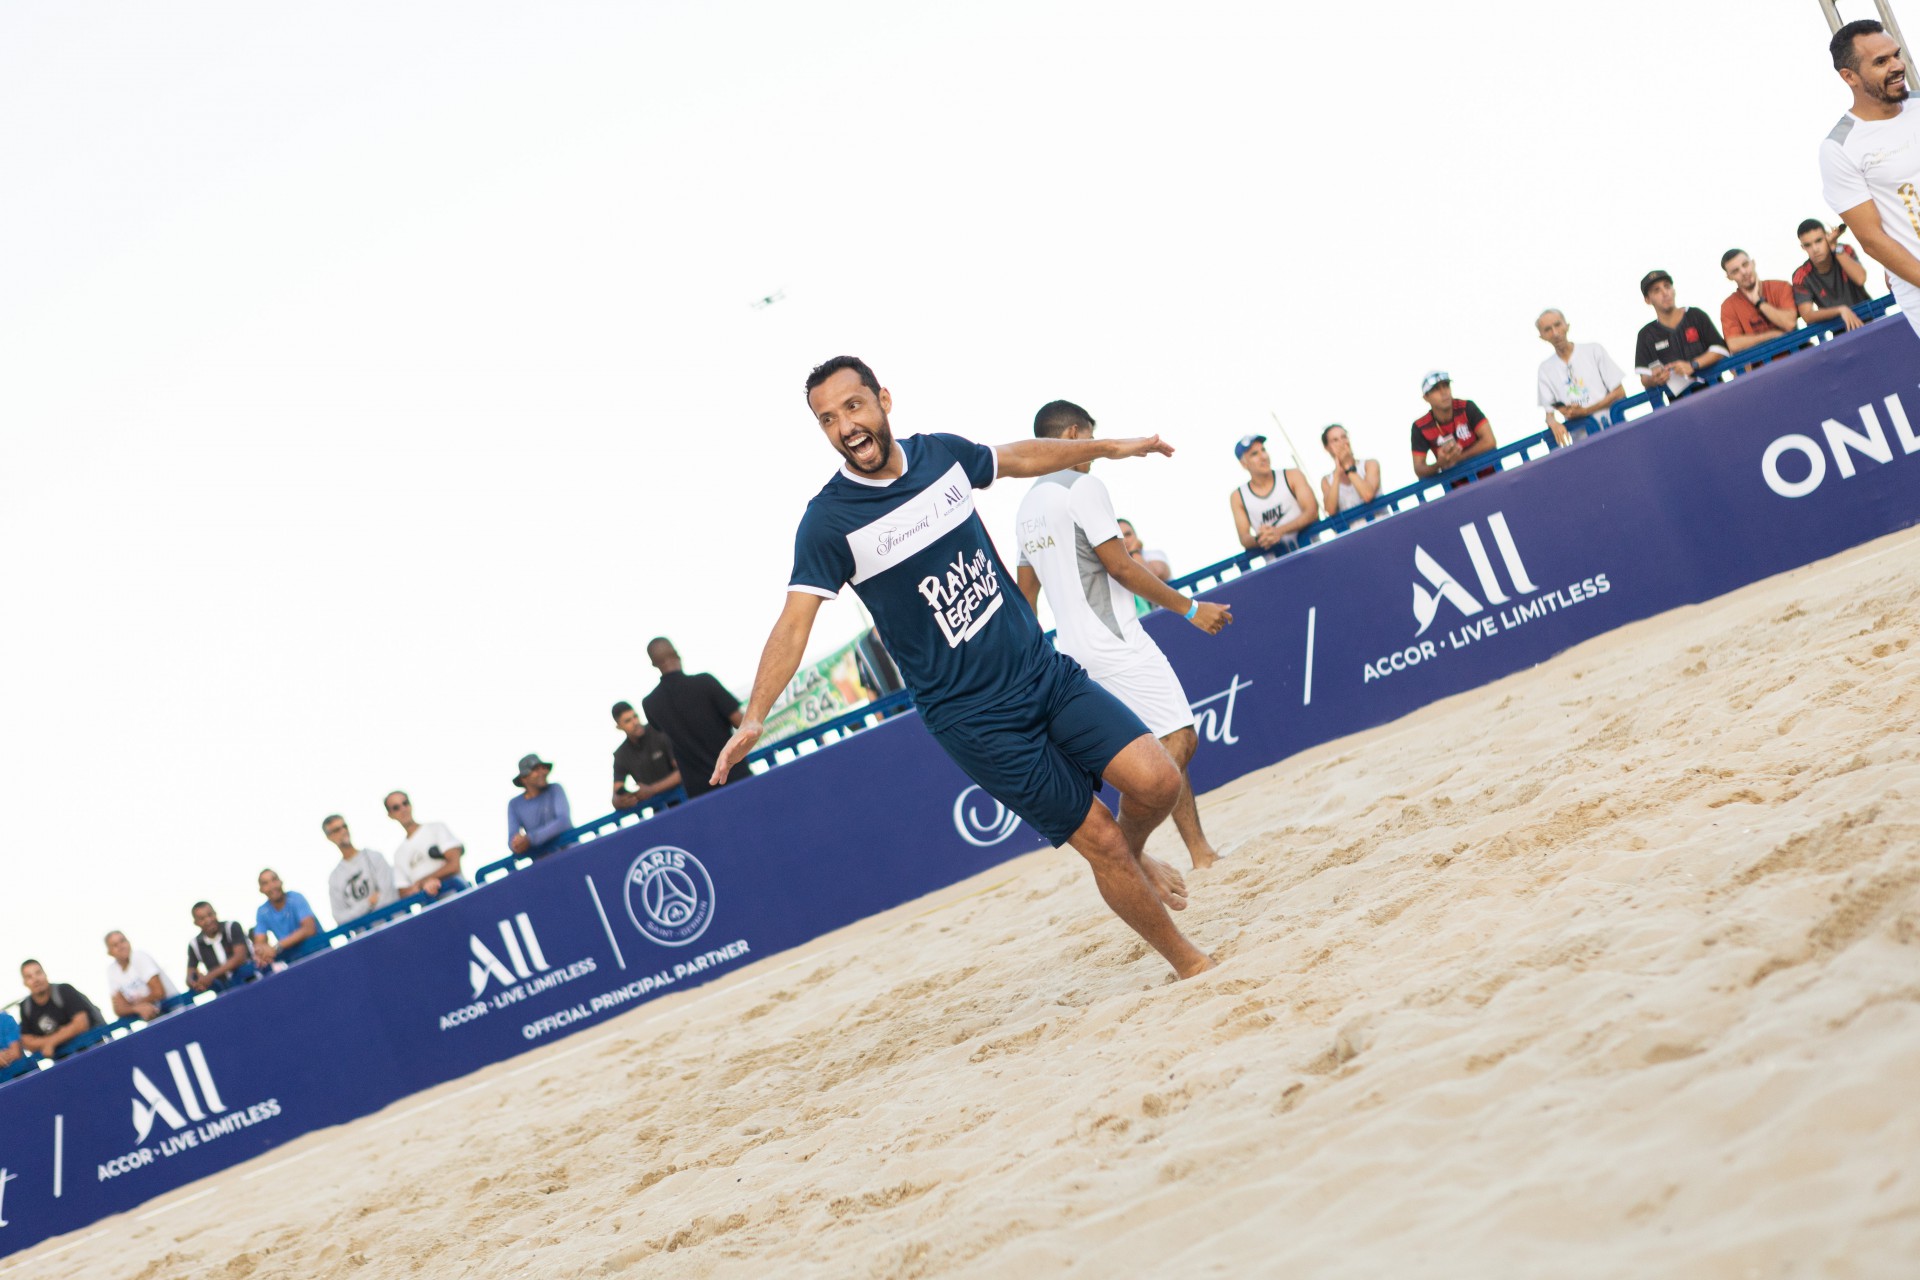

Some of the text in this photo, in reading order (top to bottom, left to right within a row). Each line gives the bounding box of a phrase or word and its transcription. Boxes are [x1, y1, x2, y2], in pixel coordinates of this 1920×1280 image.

[1762, 384, 1920, 498] ONL
[876, 515, 930, 556] Fairmont
[918, 551, 968, 611] PLAY
[1363, 573, 1611, 684] ACCOR LIVE LIMITLESS
[804, 687, 837, 723] 84
[632, 851, 686, 886] PARIS
[439, 957, 598, 1031] ACCOR LIVE LIMITLESS
[522, 939, 751, 1040] OFFICIAL PRINCIPAL PARTNER
[97, 1098, 282, 1182] ACCOR LIVE LIMITLESS
